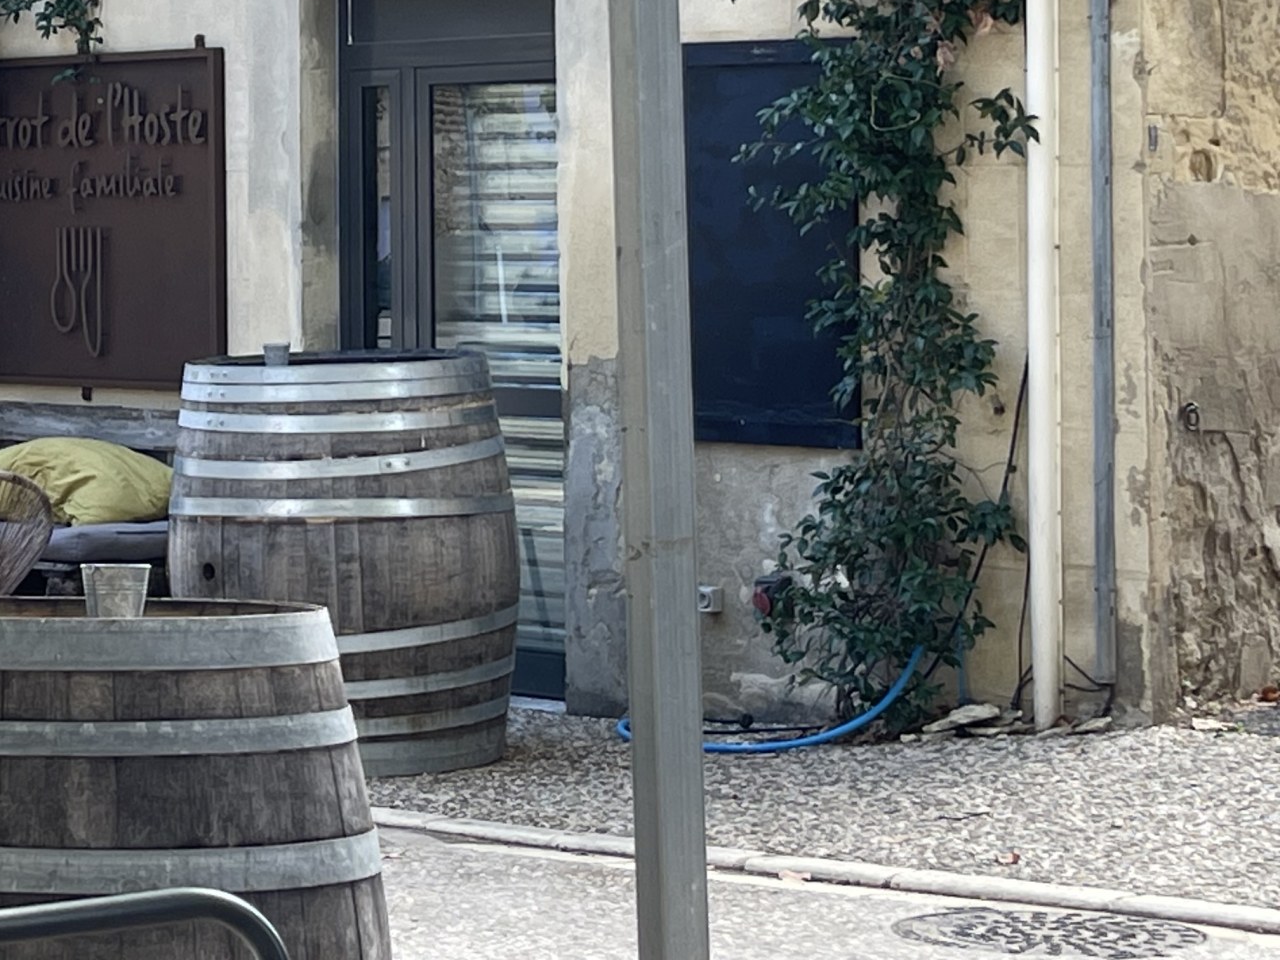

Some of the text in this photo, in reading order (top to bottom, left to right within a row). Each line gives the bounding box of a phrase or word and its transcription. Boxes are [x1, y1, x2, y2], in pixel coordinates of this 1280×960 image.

[57, 91, 94, 149] de
[106, 82, 206, 147] l'Hoste
[70, 150, 177, 215] familiale
